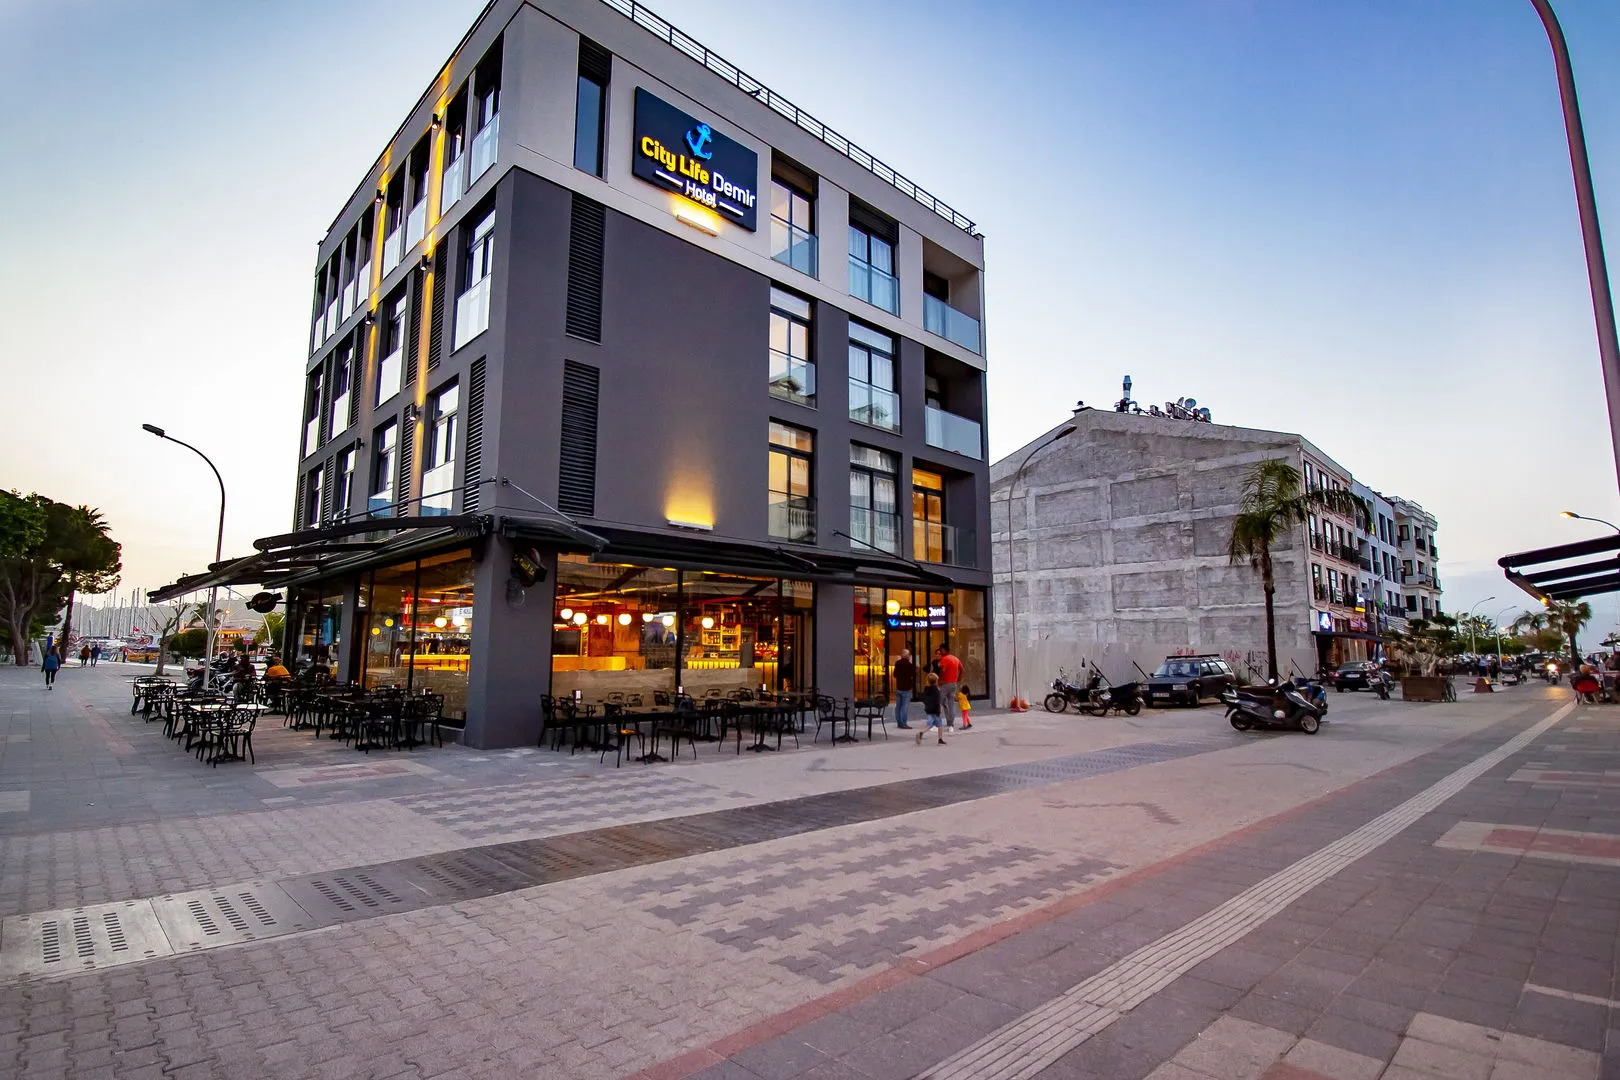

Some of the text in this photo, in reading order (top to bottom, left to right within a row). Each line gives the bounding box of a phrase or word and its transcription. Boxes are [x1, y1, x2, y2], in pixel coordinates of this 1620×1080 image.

[641, 136, 756, 208] City Life Demir
[685, 180, 717, 208] Hotel
